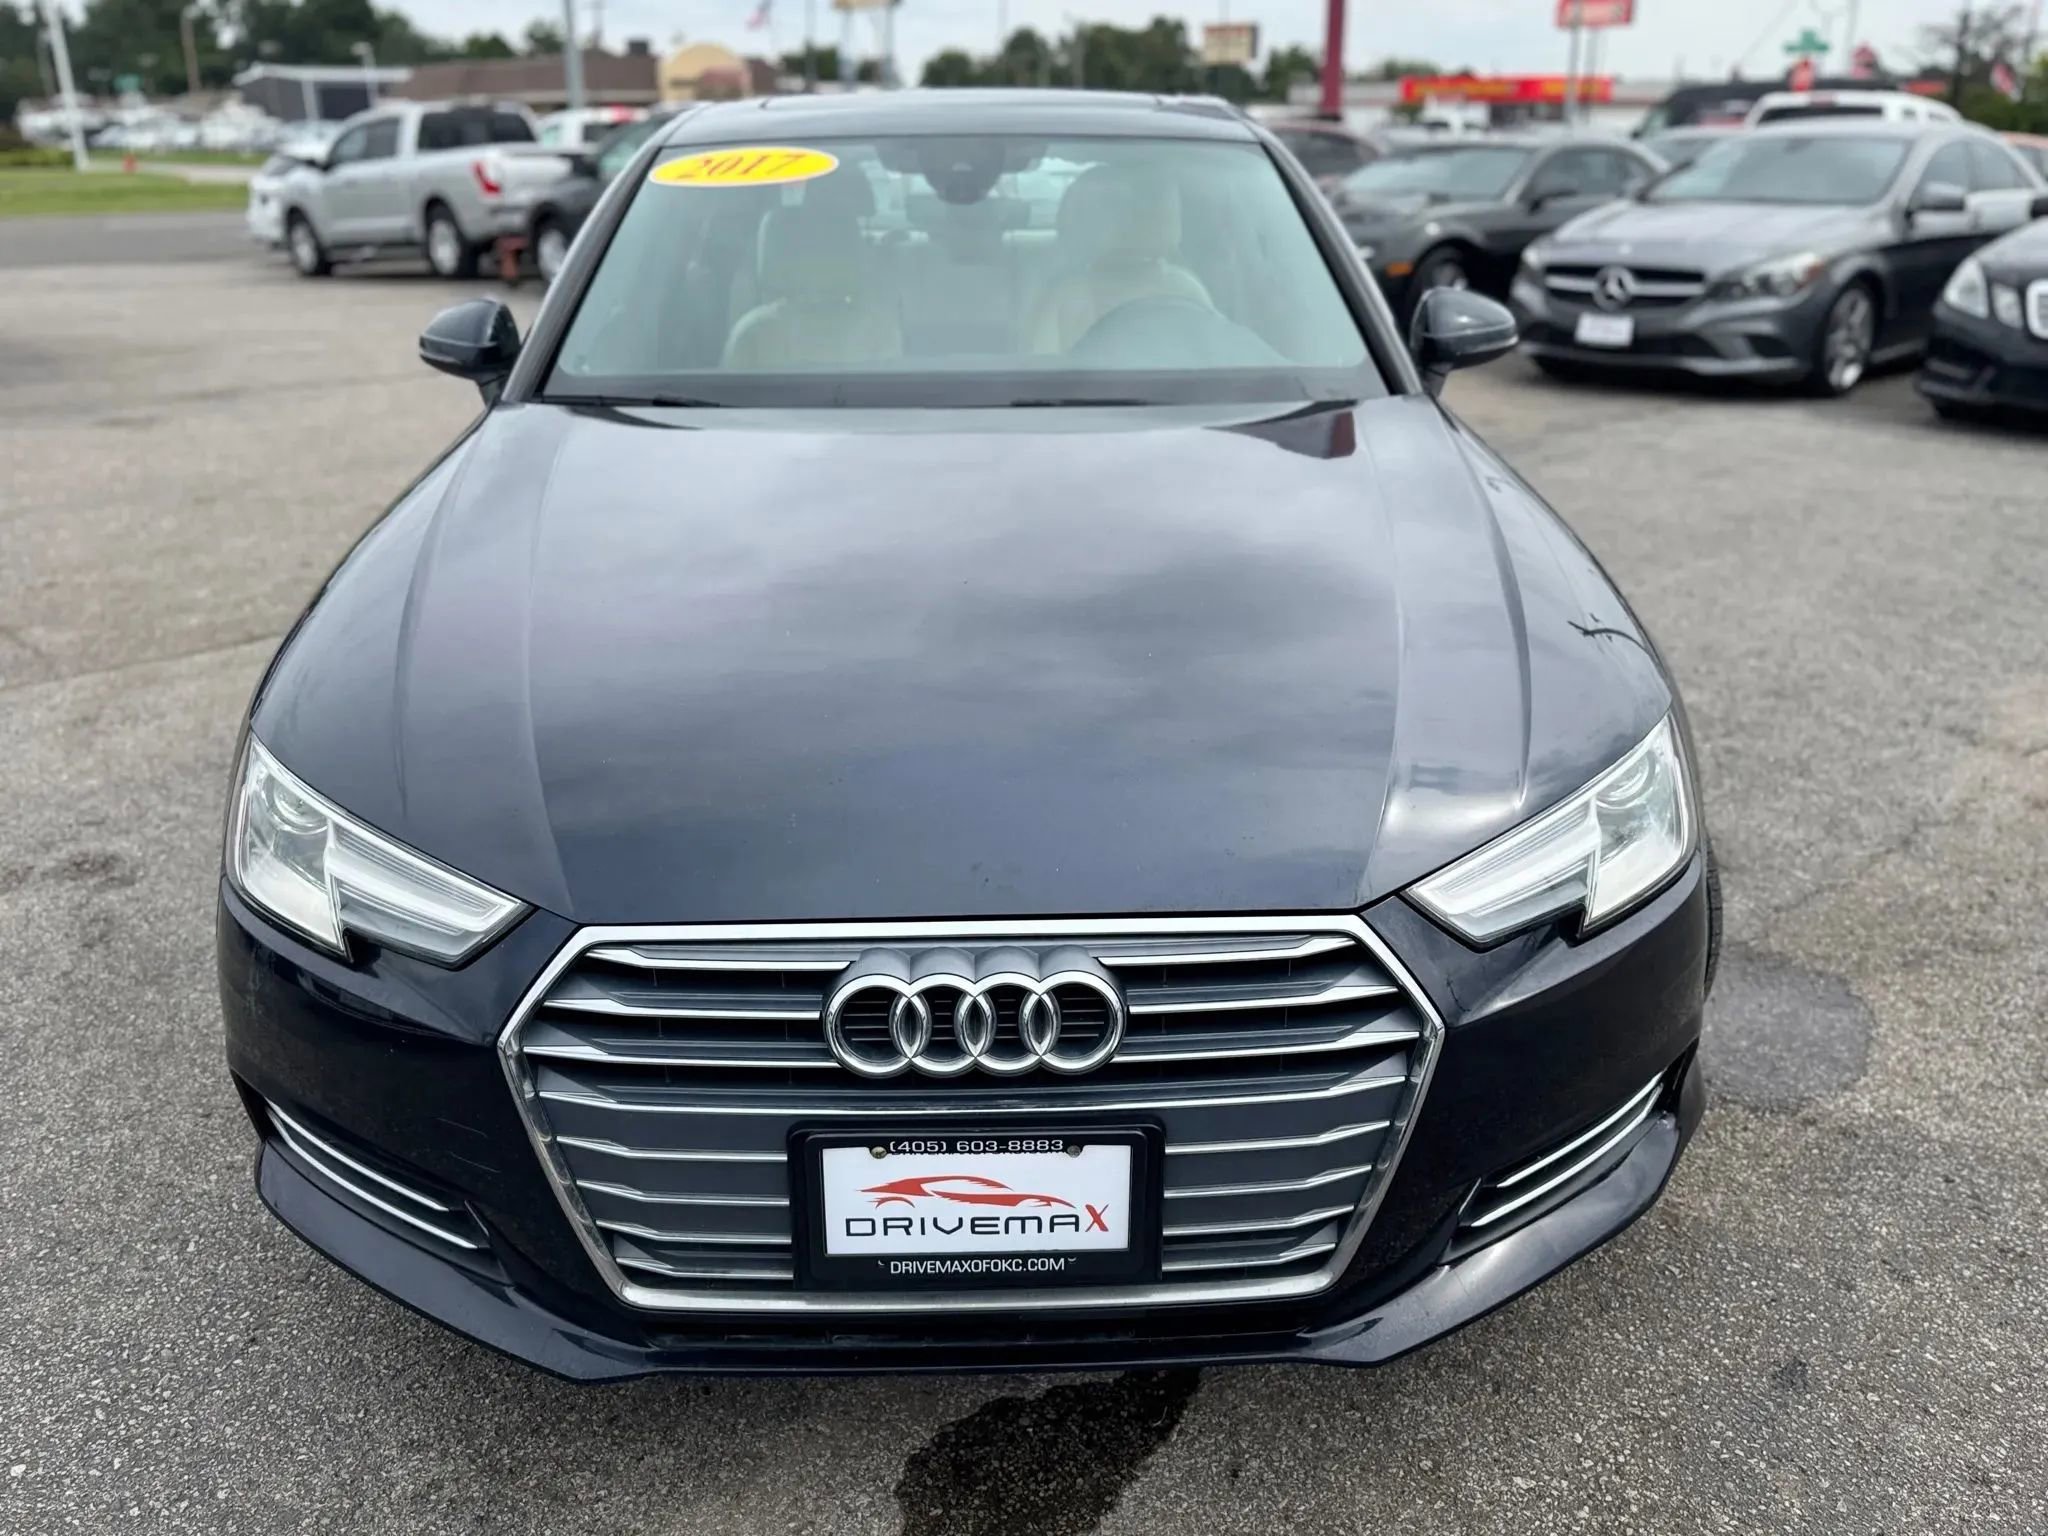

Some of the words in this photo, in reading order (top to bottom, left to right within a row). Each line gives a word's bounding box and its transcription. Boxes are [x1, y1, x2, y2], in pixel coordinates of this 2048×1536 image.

[676, 154, 807, 179] 2017
[889, 1140, 947, 1152] (405)
[956, 1139, 1064, 1152] 603-8883
[845, 1203, 1110, 1237] DRIVEMAX
[889, 1257, 1066, 1275] DRIVEMAXOFOKC.COM
